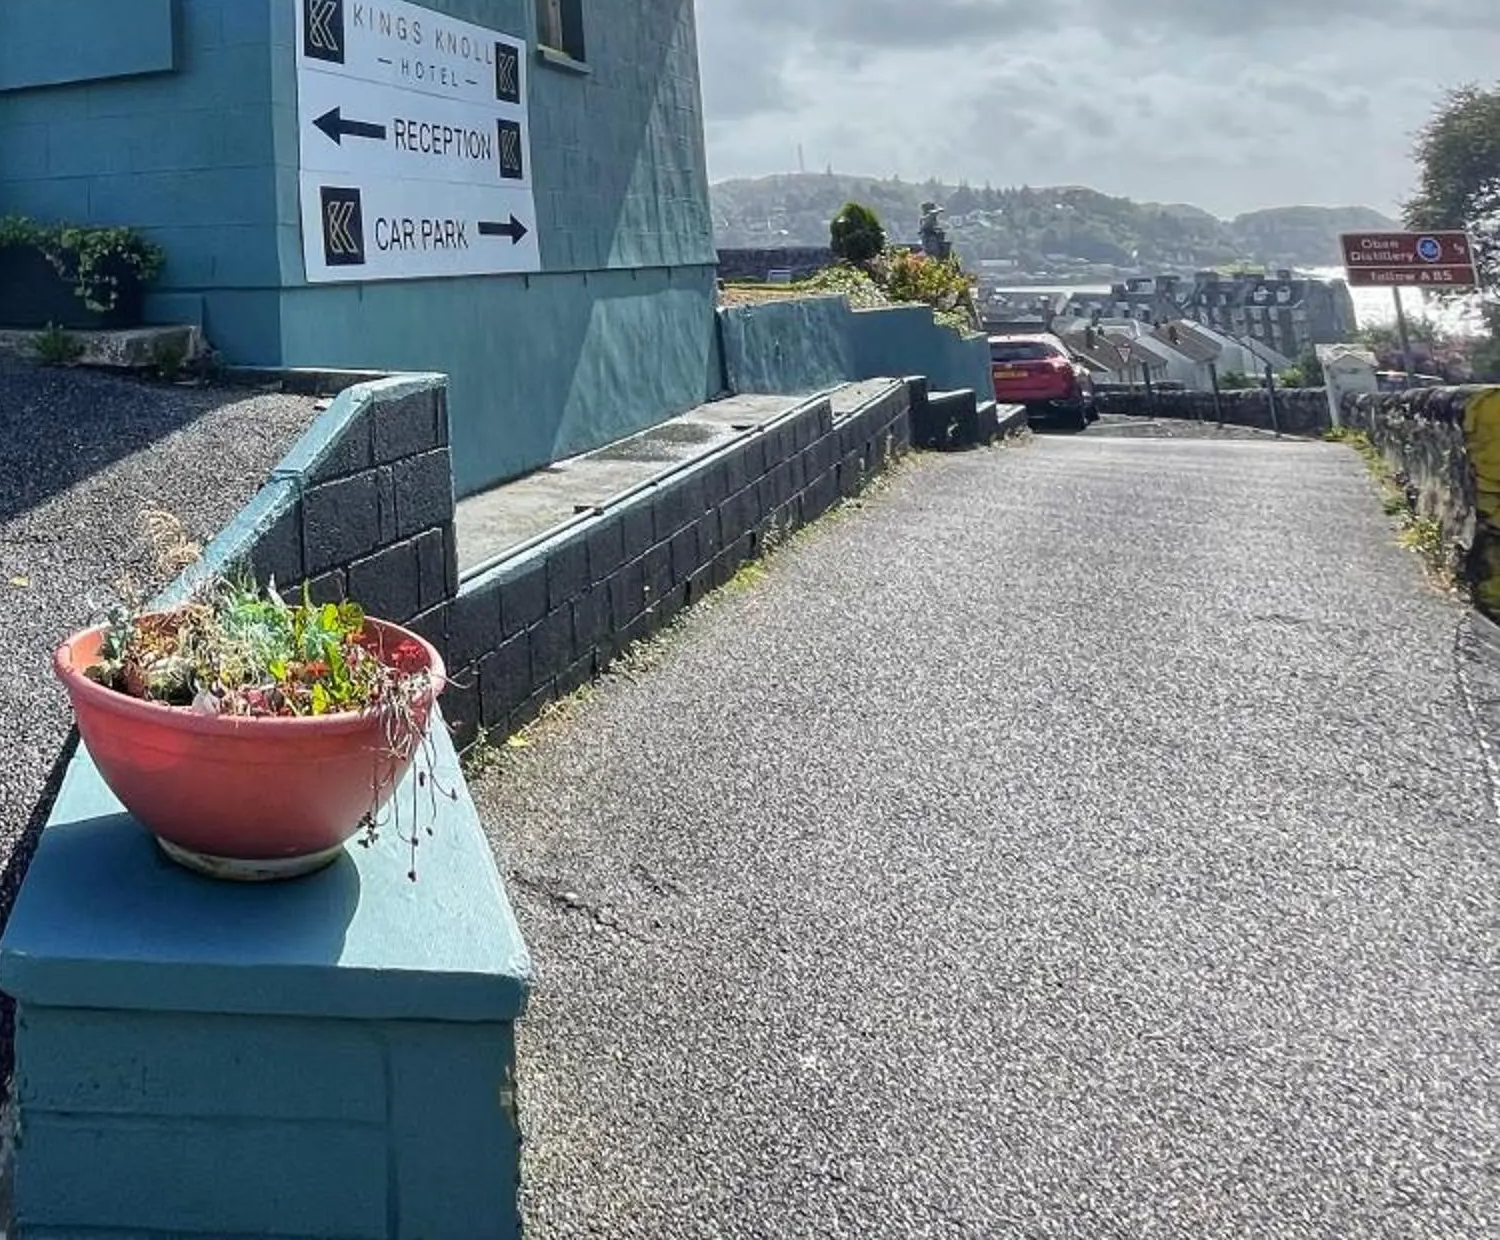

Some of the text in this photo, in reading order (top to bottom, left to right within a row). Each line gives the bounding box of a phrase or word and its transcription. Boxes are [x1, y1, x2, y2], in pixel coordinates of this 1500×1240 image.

[353, 2, 493, 65] KINGS KNOLL
[401, 61, 459, 87] HOTEL
[394, 118, 491, 160] RECEPTION
[375, 217, 469, 251] CAR PARK
[1361, 239, 1399, 249] Oban
[1350, 251, 1415, 262] Distillery
